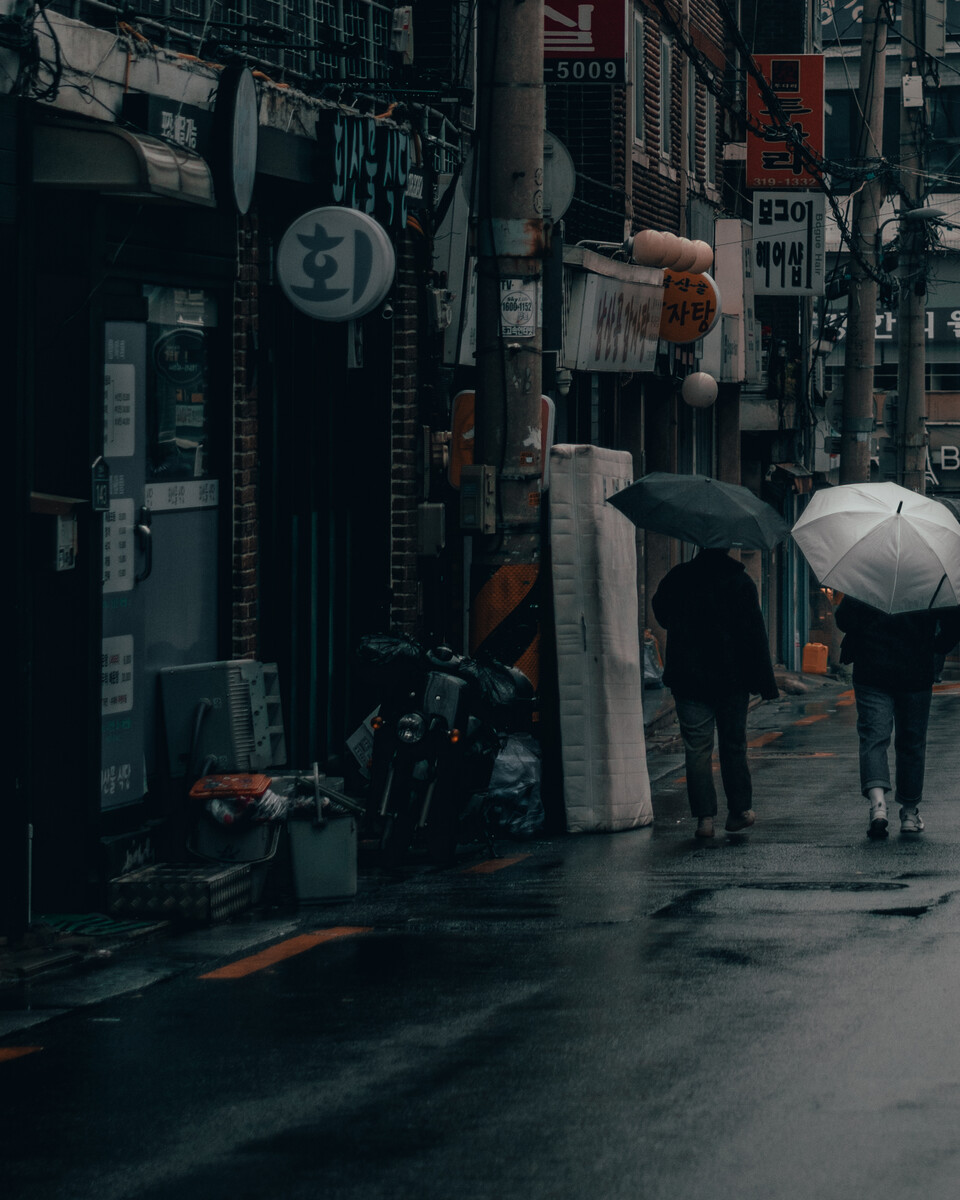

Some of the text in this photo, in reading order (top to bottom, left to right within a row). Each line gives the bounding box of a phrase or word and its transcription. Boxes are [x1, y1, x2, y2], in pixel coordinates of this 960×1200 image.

[753, 177, 817, 187] 319-1332
[756, 241, 804, 288] 헤어샵
[815, 253, 823, 275] Hair
[663, 300, 715, 332] 자탕
